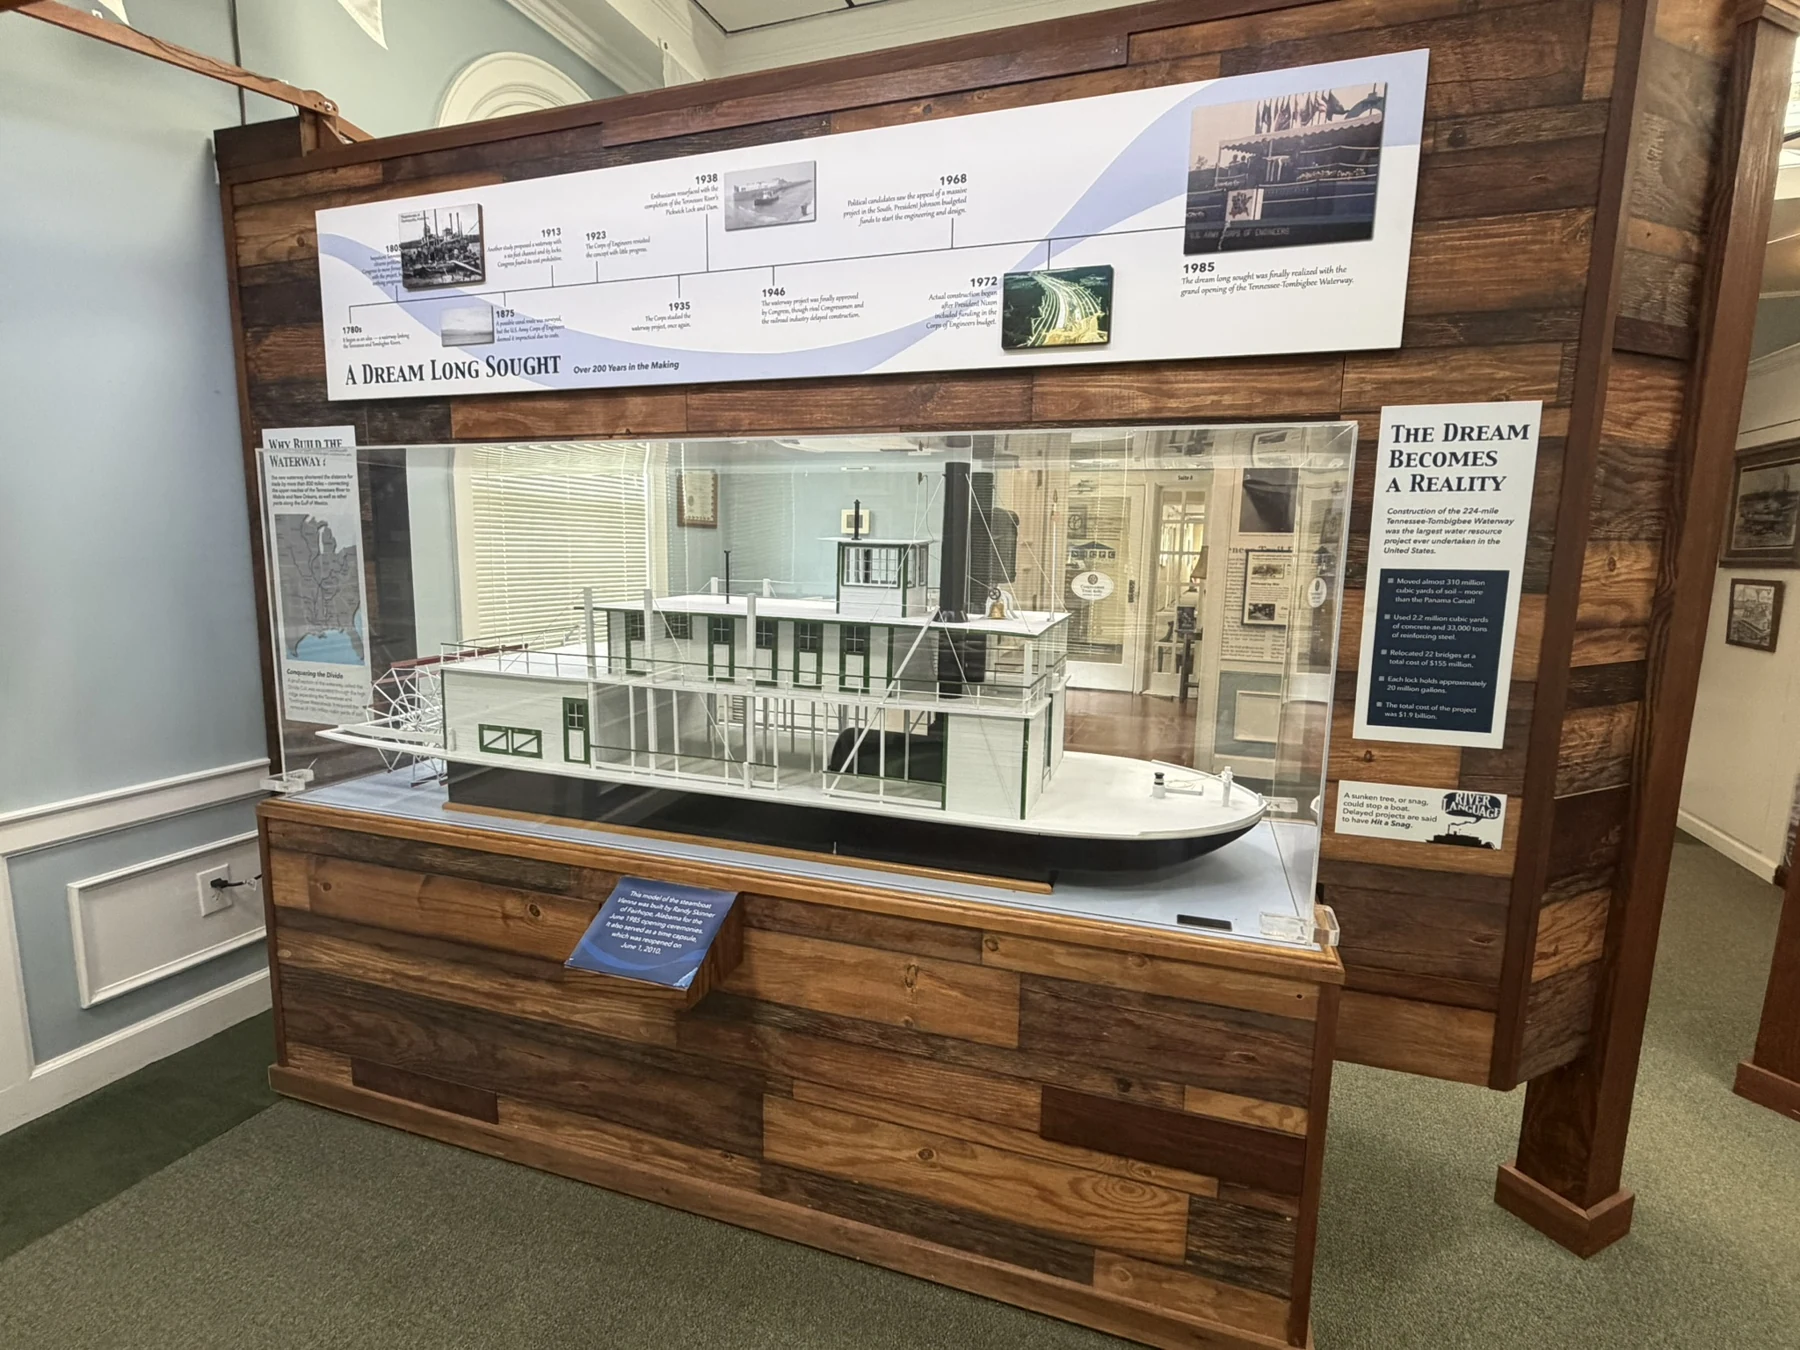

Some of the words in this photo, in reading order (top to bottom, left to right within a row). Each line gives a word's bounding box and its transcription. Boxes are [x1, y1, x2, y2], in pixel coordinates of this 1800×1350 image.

[696, 173, 718, 184] 1938
[940, 174, 967, 185] 1968
[542, 228, 561, 238] 1913
[586, 231, 606, 241] 1923
[1183, 262, 1215, 274] 1985
[1195, 276, 1215, 284] dream
[1217, 275, 1230, 283] long
[1232, 273, 1254, 282] sought
[1268, 270, 1290, 280] finally
[1291, 267, 1318, 276] realized
[970, 277, 997, 287] 1972
[762, 287, 785, 297] 1946
[668, 302, 690, 311] 1935
[496, 310, 514, 318] 1875
[346, 365, 356, 385] A
[362, 363, 424, 384] DREAM
[430, 359, 480, 380] LONG
[486, 355, 561, 377] SOUGHT
[608, 364, 626, 372] Years
[651, 360, 679, 370] Making
[1391, 424, 1434, 443] THE
[1442, 423, 1530, 442] DREAM
[269, 439, 291, 449] WHY
[1388, 450, 1498, 468] BECOMES
[1386, 477, 1401, 492] A
[1409, 474, 1507, 492] REALITY
[1387, 518, 1472, 526] Tennessee-Tombigbee
[1474, 518, 1514, 526] Waterway
[1416, 528, 1442, 536] largest
[1384, 538, 1411, 546] project
[1400, 633, 1436, 641] reinforcing
[287, 668, 316, 678] Conquering
[1455, 792, 1491, 807] RIVER
[1442, 798, 1500, 818] LANGUAGE
[1343, 808, 1373, 817] Delayed
[1376, 811, 1405, 820] projects
[1391, 820, 1413, 829] Snag.
[643, 893, 661, 902] model
[680, 898, 712, 909] steamboat
[618, 897, 636, 906] Vienna
[673, 906, 691, 915] Randy
[692, 909, 716, 918] Skinner
[655, 912, 681, 921] Alabama
[624, 925, 644, 933] served
[626, 916, 640, 924] 1985
[641, 919, 666, 929] opening
[667, 923, 703, 934] ceremonies.
[612, 932, 629, 940] which
[643, 937, 672, 947] reopened
[621, 942, 636, 950] June
